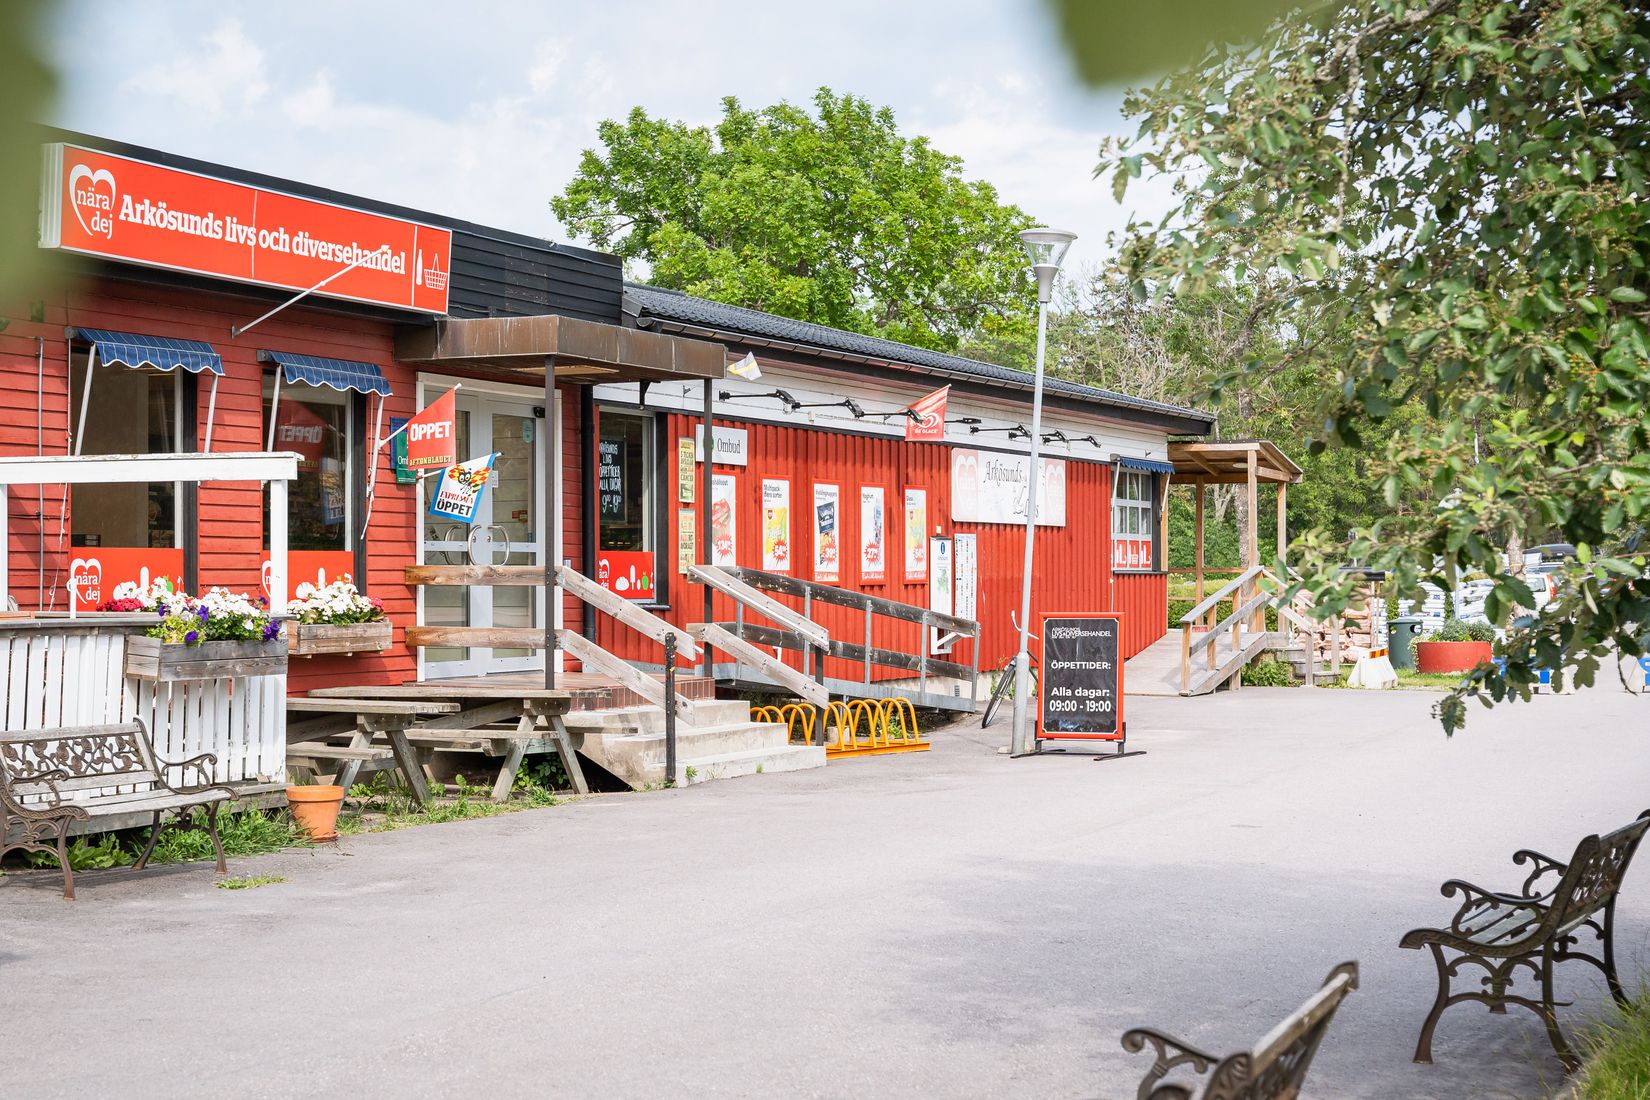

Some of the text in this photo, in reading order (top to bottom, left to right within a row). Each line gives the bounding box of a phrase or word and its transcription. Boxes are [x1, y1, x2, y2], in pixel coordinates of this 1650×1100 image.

[77, 187, 111, 211] nära
[91, 211, 113, 240] dej
[119, 194, 406, 275] Arkösunds livs och diversehandel
[410, 421, 452, 442] ÖPPET
[717, 437, 741, 454] Ombud
[983, 459, 1023, 487] Arkösunds
[437, 497, 473, 516] ÖPPET
[76, 572, 98, 585] nära
[85, 586, 100, 604] dej
[1051, 660, 1111, 670] ÖPPETTIDER:
[1051, 687, 1110, 699] Alla dagar:
[1049, 700, 1077, 712] 09:00
[1086, 700, 1111, 712] 19:00
